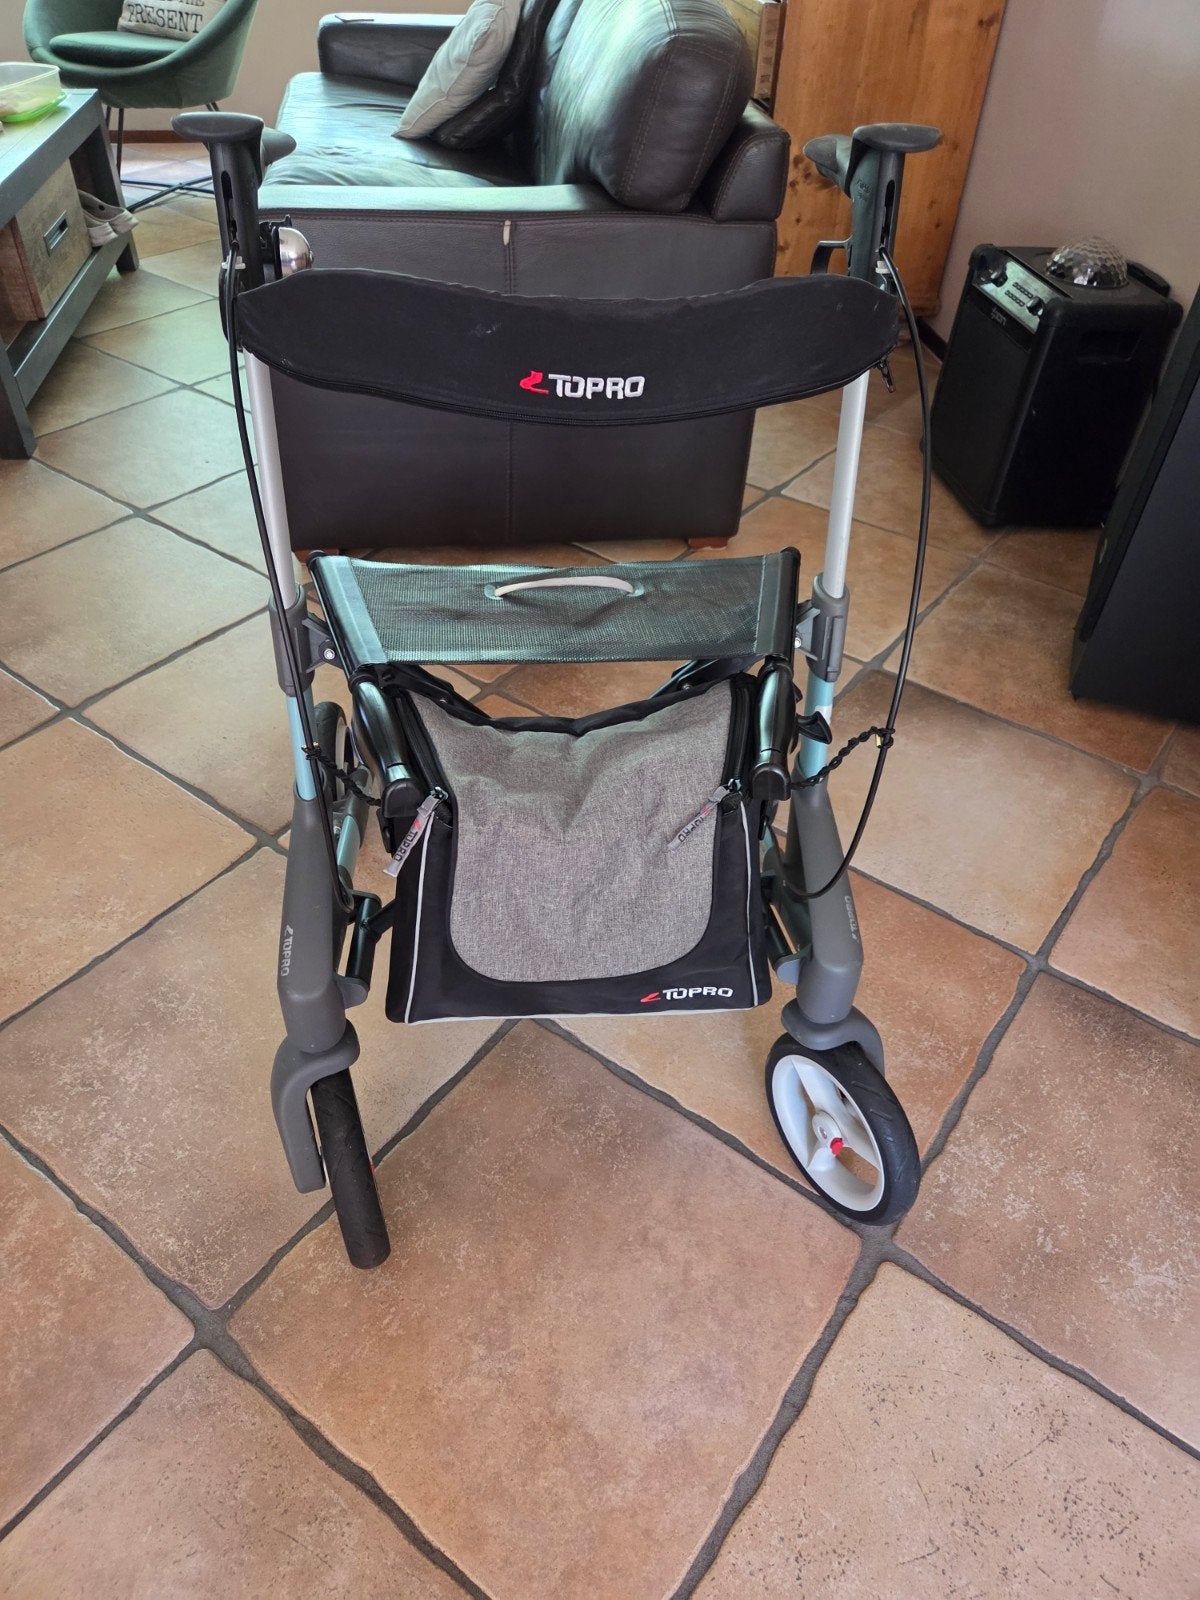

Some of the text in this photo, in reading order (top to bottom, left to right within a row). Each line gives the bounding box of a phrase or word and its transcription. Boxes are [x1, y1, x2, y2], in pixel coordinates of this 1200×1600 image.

[127, 4, 203, 33] PRESENT
[548, 373, 645, 400] TOPRO
[394, 830, 419, 862] TOPRO
[280, 936, 294, 977] TOPRO
[662, 986, 734, 1000] TOPRO
